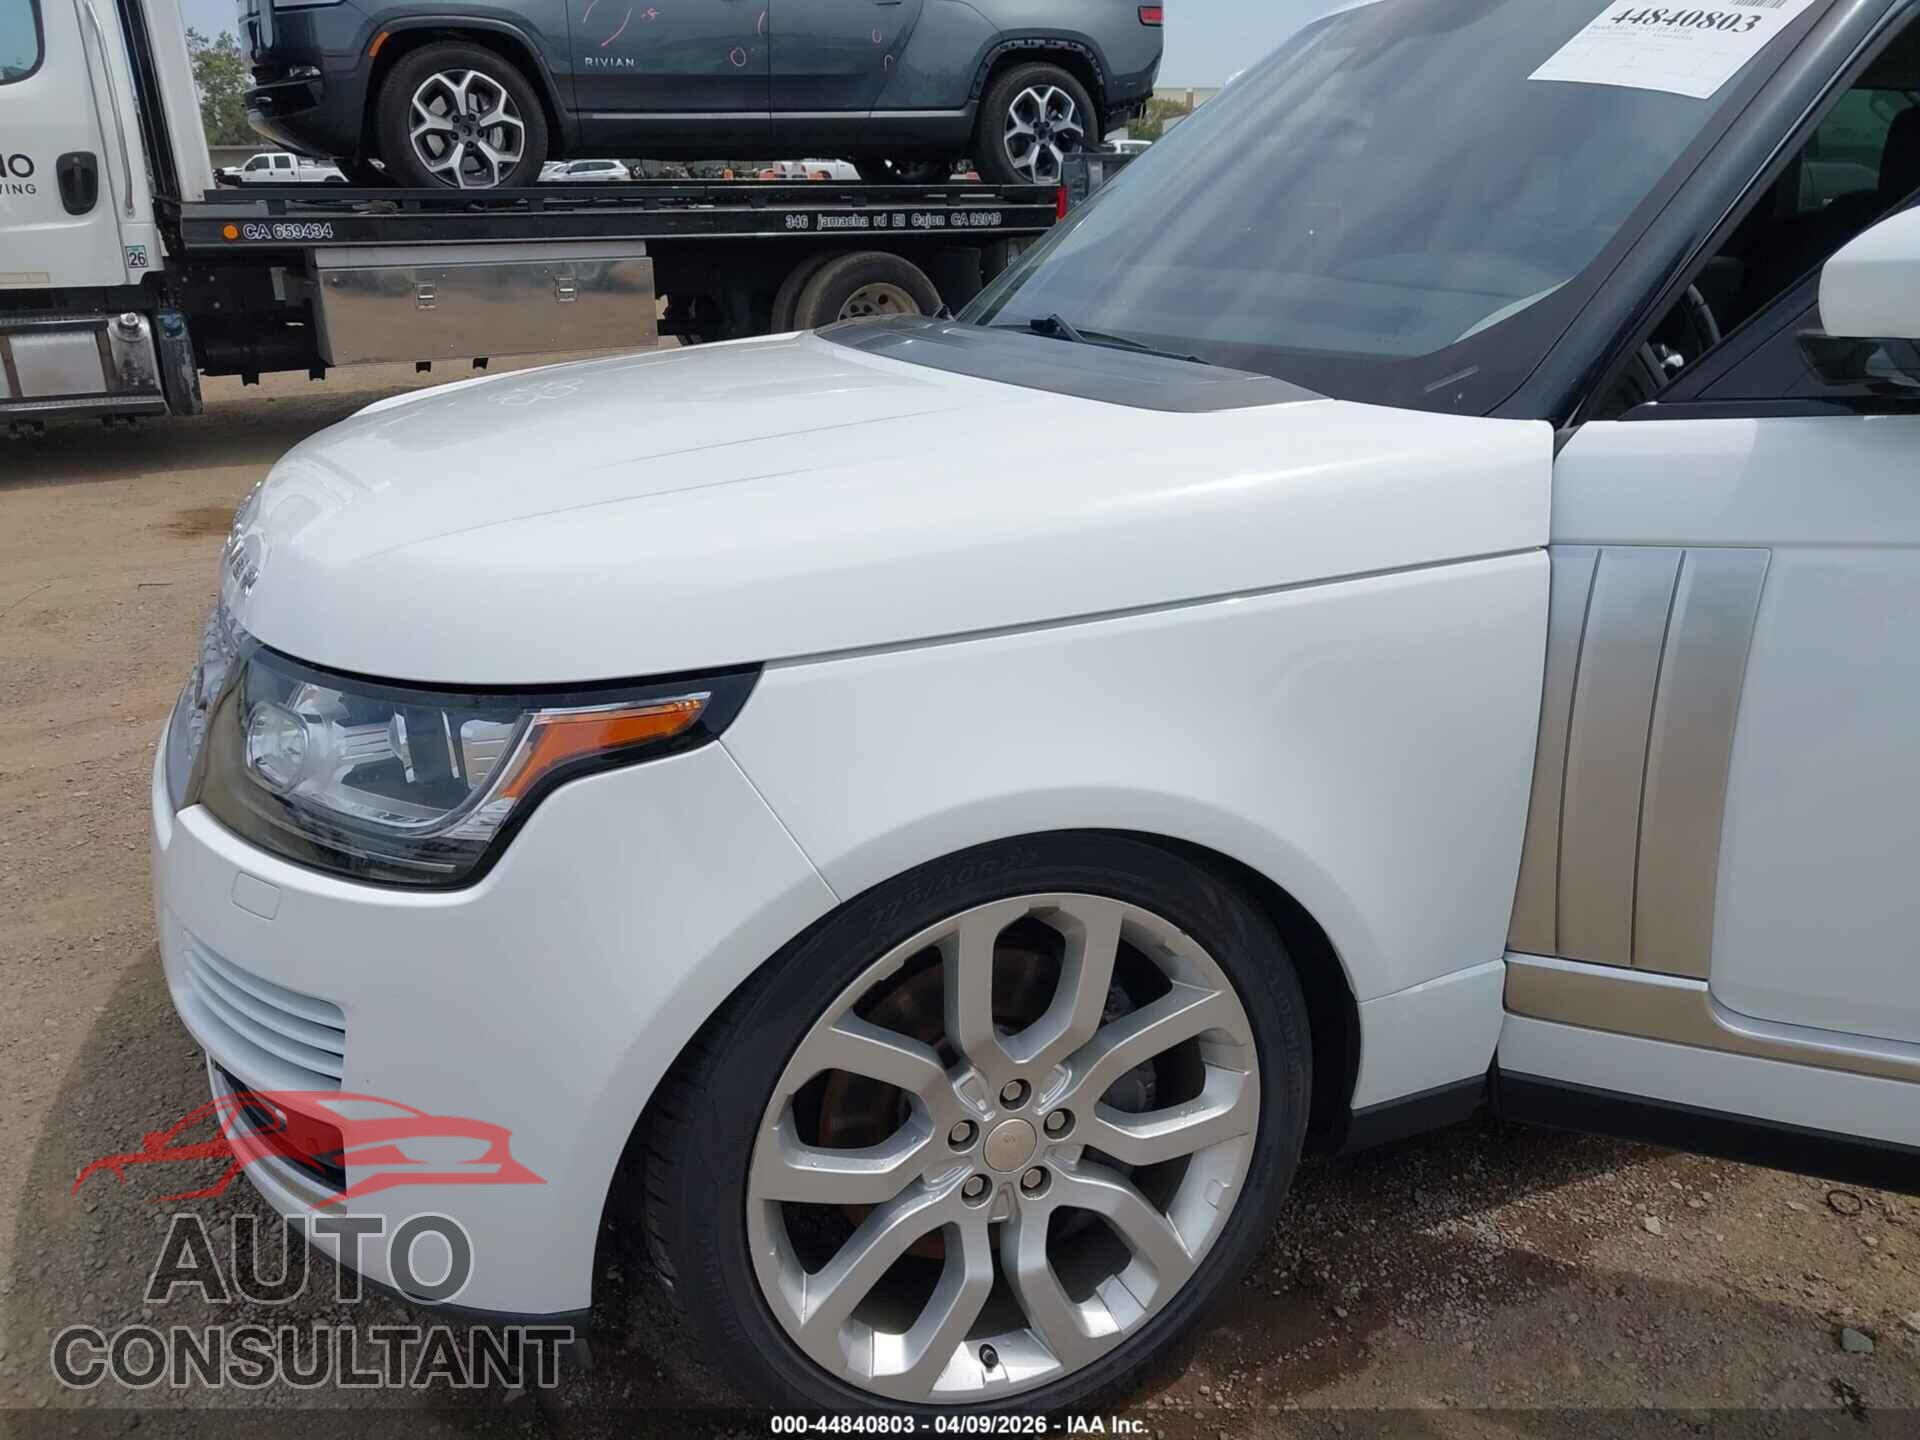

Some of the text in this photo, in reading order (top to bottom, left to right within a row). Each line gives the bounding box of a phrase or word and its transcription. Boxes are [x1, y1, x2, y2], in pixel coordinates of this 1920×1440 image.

[1610, 8, 1762, 32] 44840803
[584, 57, 635, 67] RIVIAN
[816, 213, 869, 230] jamacha
[873, 213, 887, 226] rd
[893, 213, 905, 226] El
[911, 213, 945, 228] Cajon
[950, 212, 969, 226] CA
[243, 223, 333, 239] CA 659434
[128, 252, 146, 266] 26
